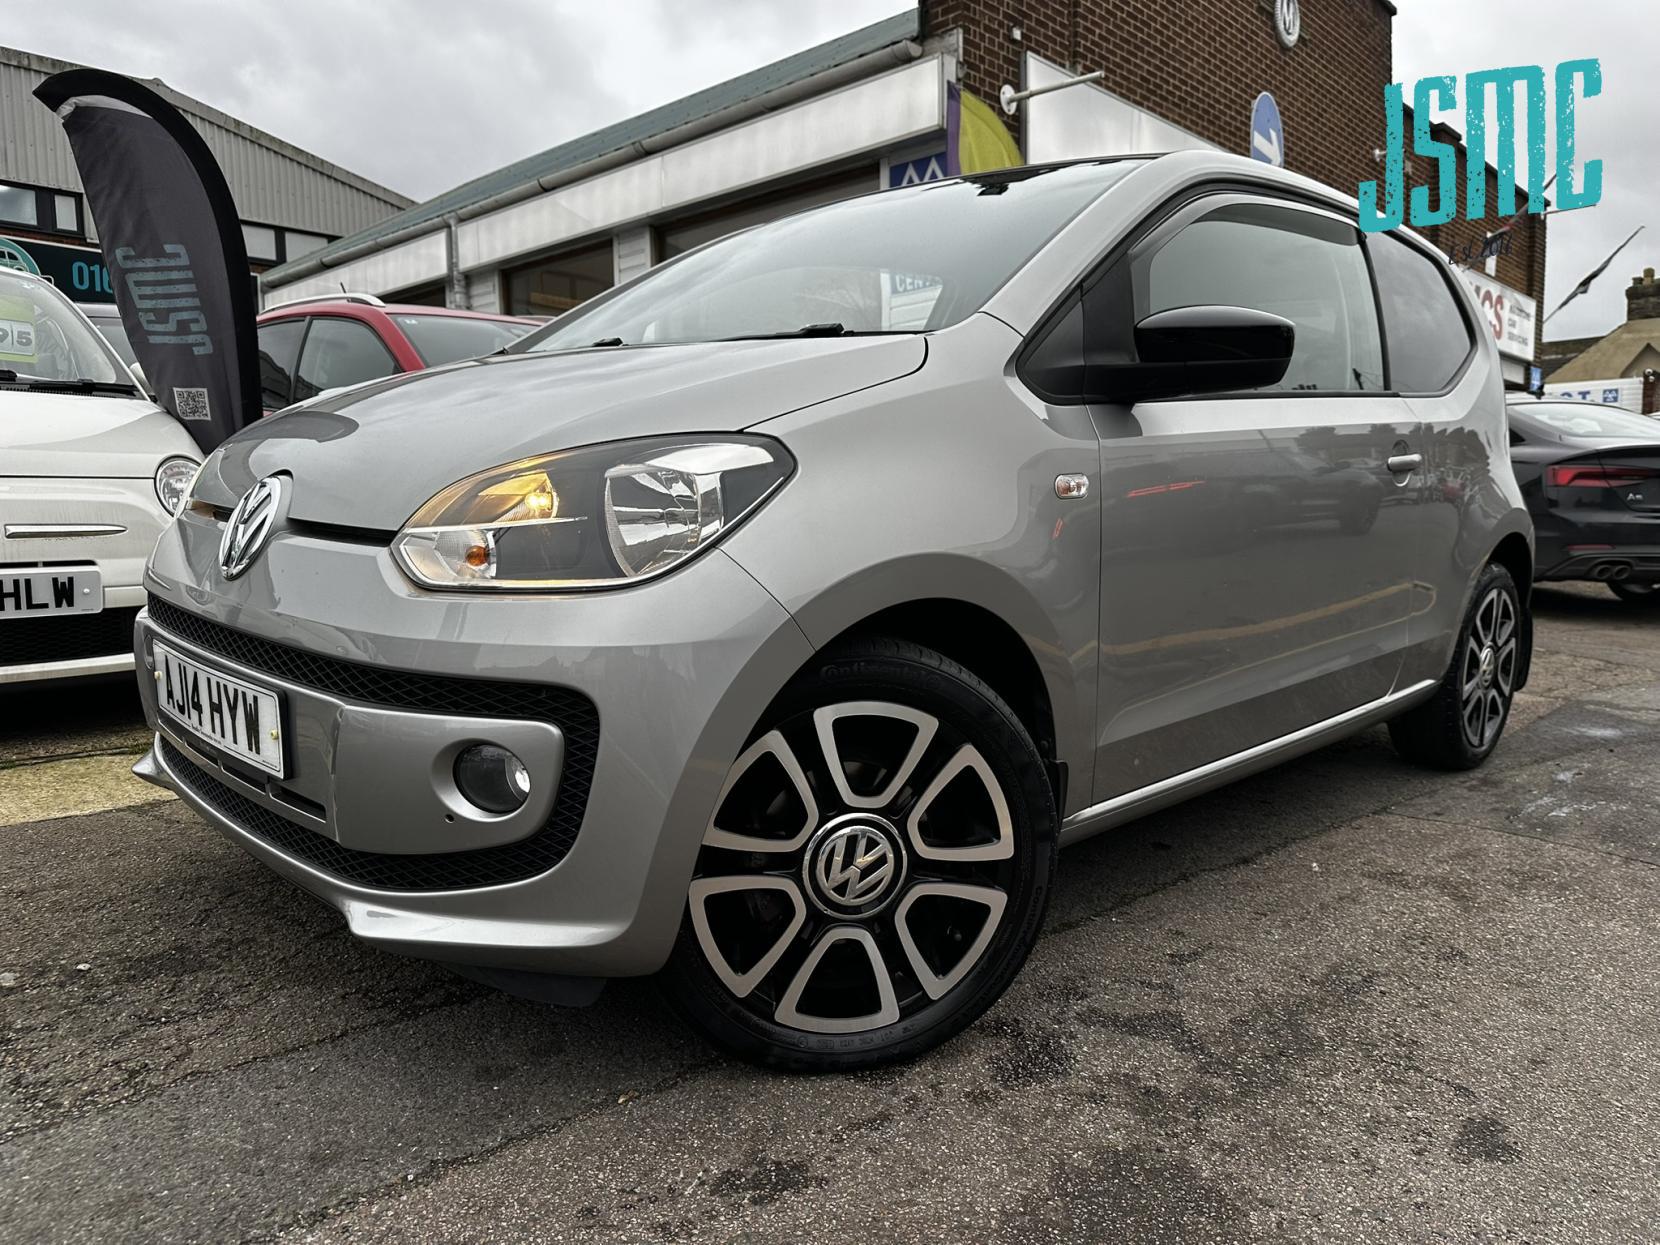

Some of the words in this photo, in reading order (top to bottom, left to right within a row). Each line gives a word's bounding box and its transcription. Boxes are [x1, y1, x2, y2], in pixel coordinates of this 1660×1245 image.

[115, 243, 214, 356] JSMC
[0, 576, 75, 612] HLW
[164, 653, 203, 728] AJ14
[206, 676, 261, 756] HYW
